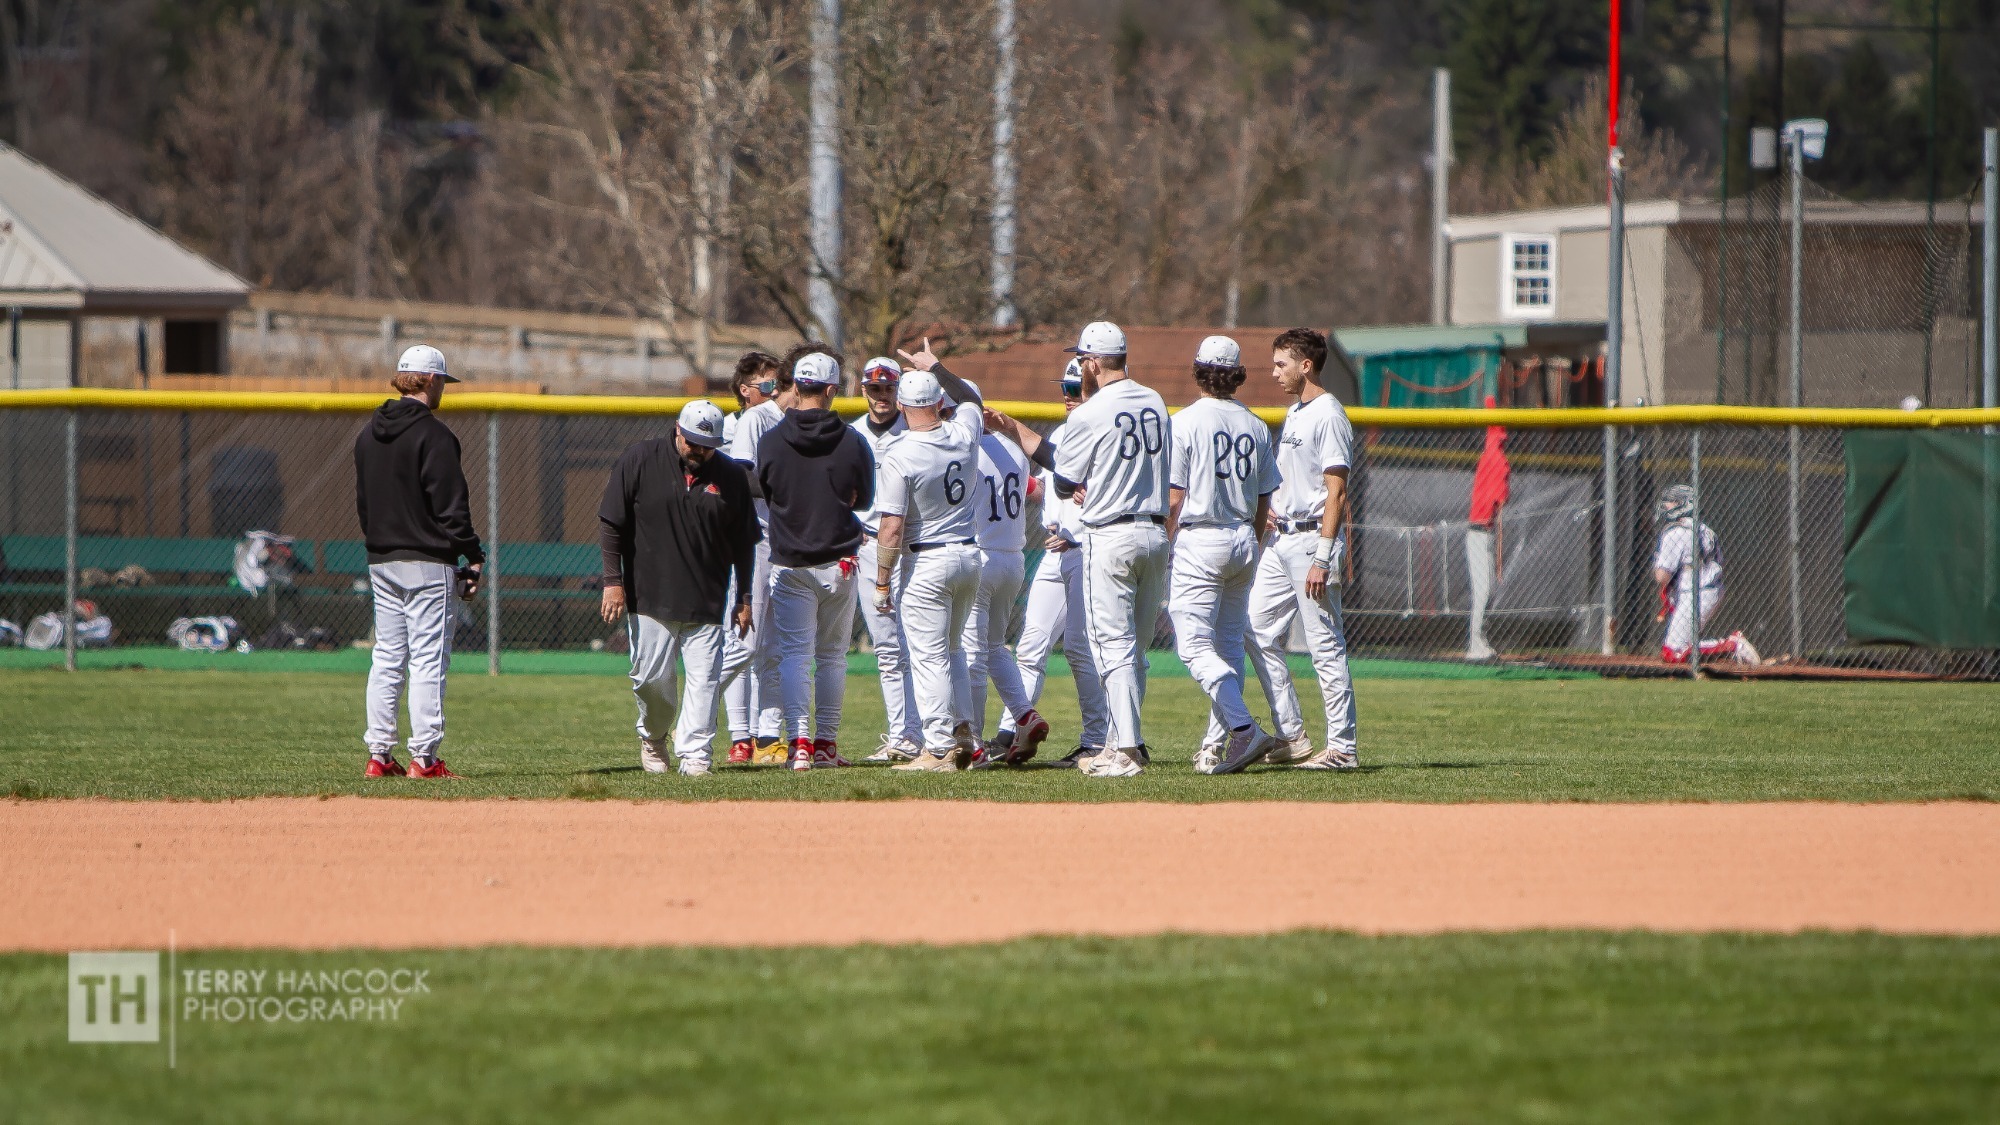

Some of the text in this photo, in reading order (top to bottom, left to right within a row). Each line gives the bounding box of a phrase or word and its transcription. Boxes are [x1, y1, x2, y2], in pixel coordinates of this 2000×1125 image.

[1115, 407, 1162, 460] 30
[1213, 430, 1255, 482] 28
[944, 461, 965, 505] 6
[984, 471, 1021, 522] 16
